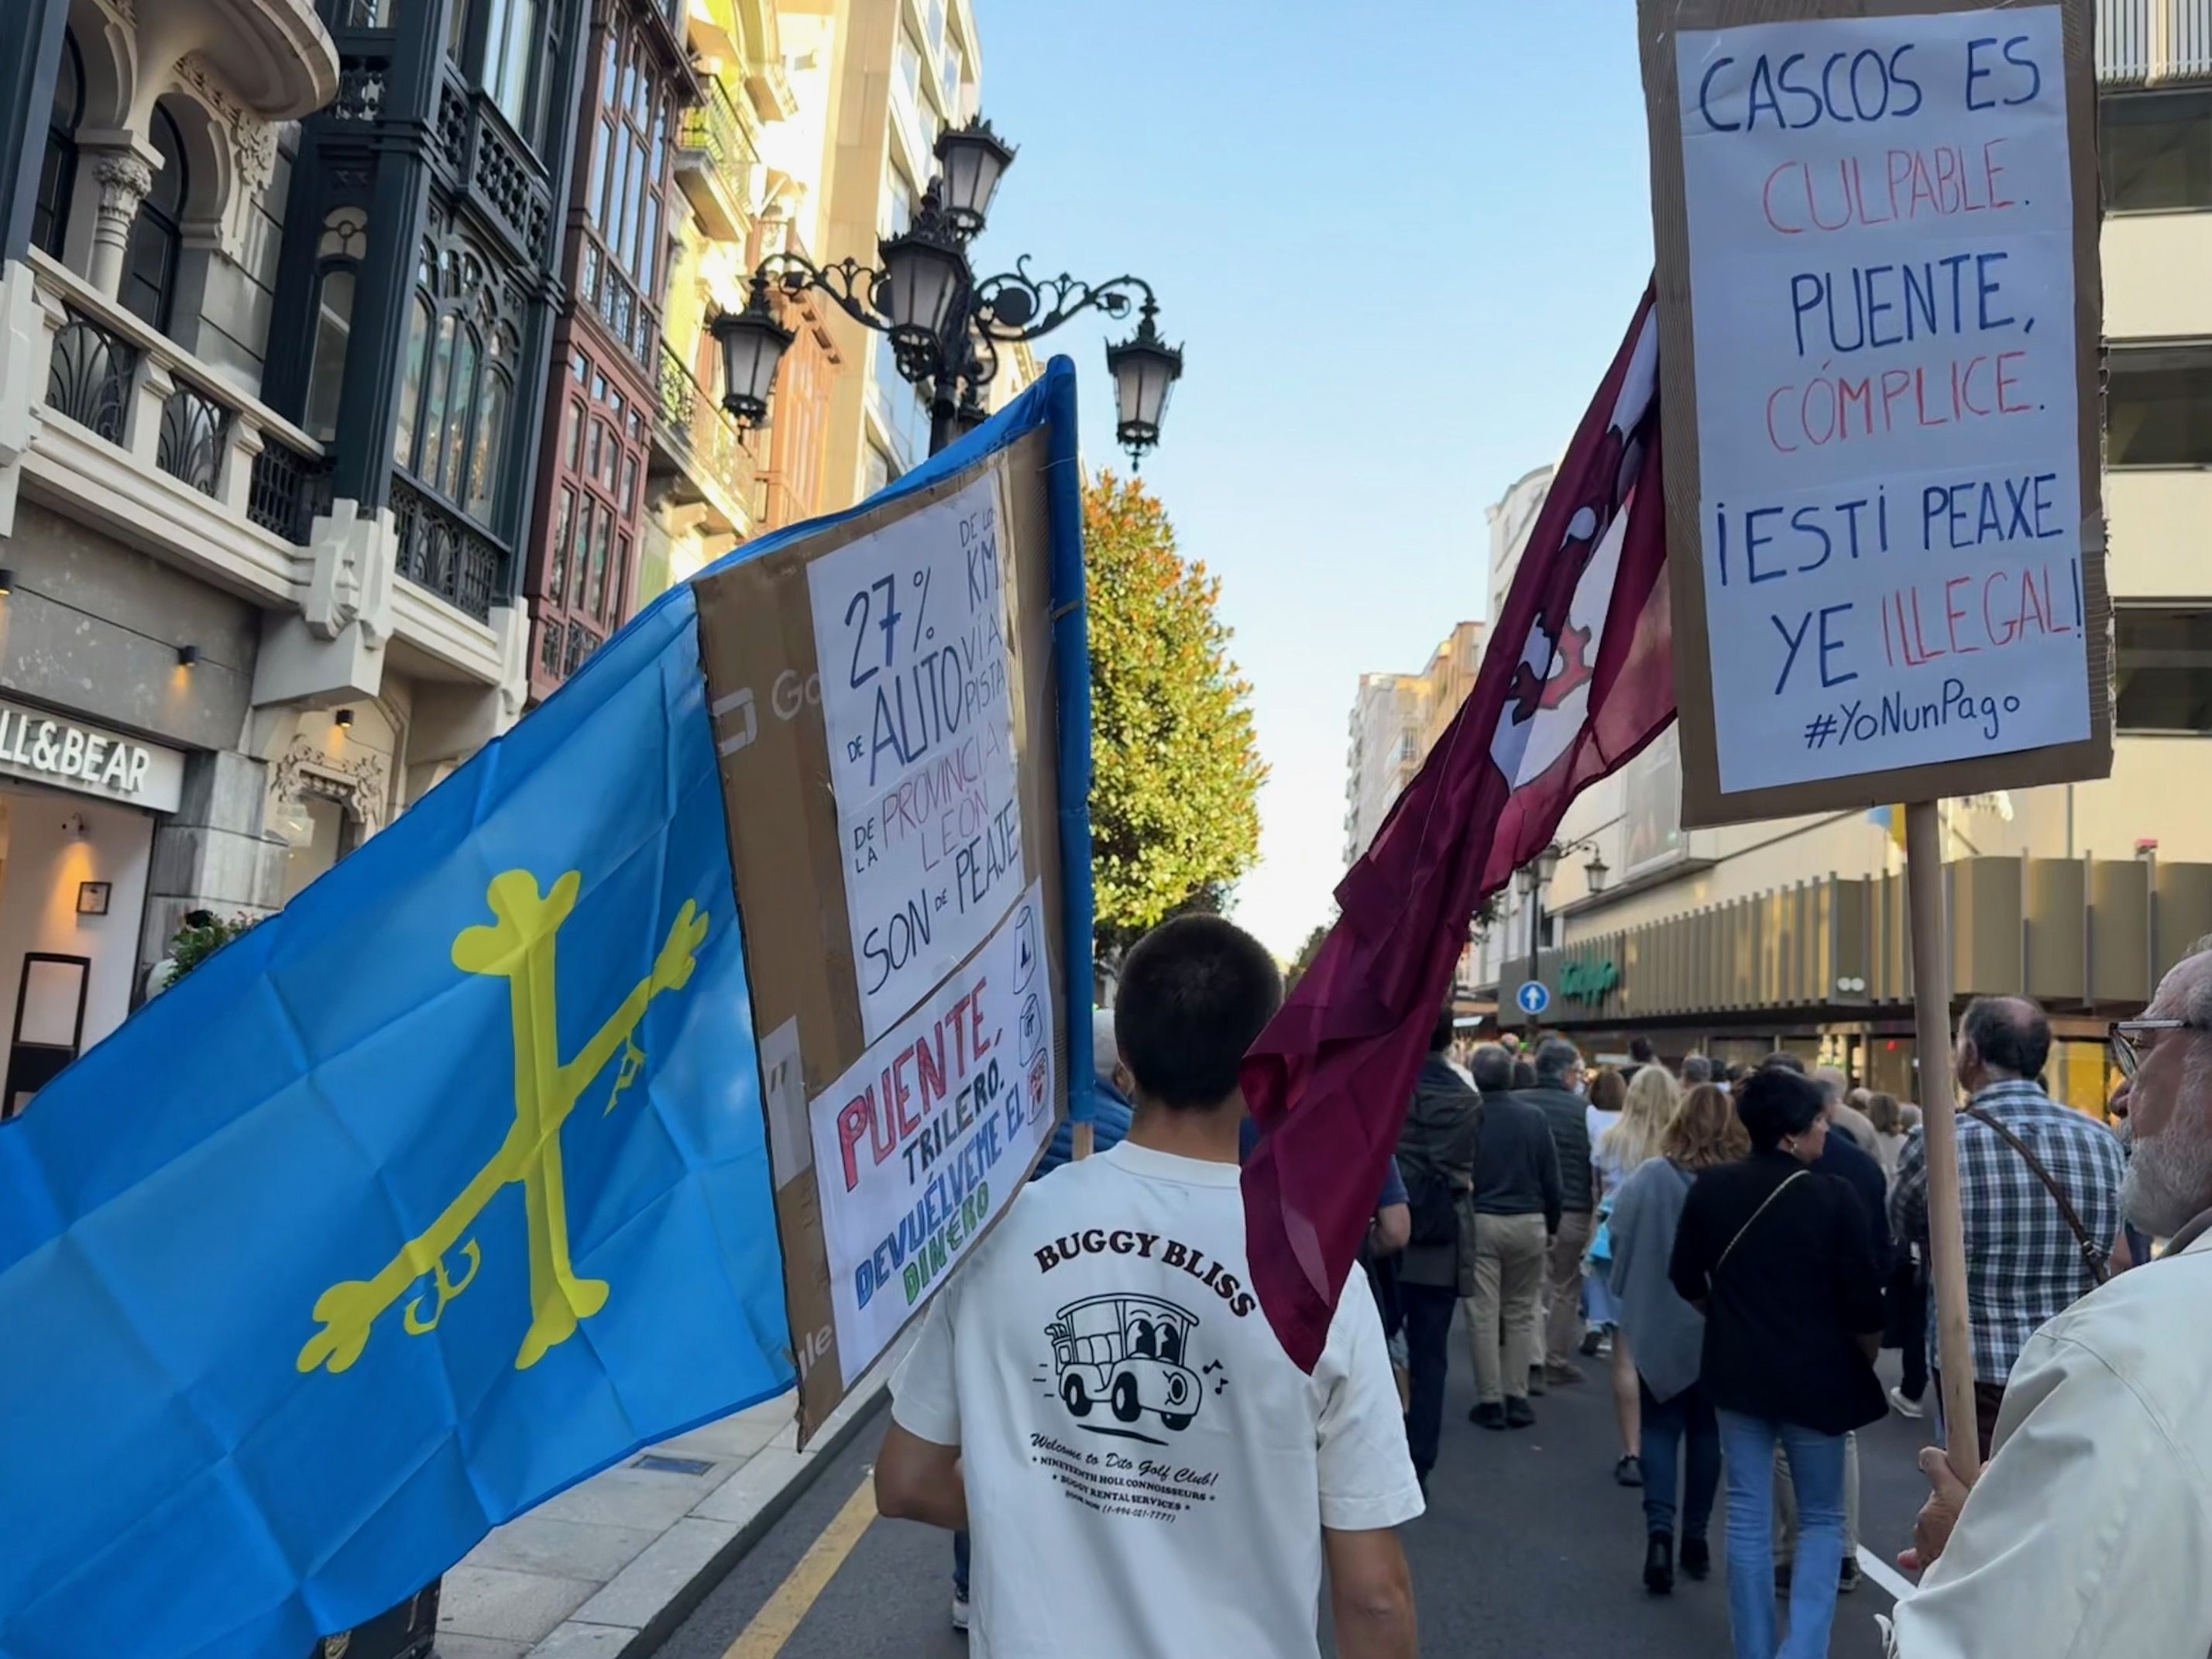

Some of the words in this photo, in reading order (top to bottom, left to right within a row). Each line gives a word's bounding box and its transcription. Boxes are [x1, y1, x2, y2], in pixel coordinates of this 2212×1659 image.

[1699, 44, 1922, 132] CASCOS
[1966, 36, 2041, 110] ES
[1762, 138, 2031, 234] CULPABLE.
[1791, 252, 2035, 356] PUENTE,
[1766, 351, 2045, 452] CÓMPLICE.
[959, 513, 977, 548] DE
[1922, 472, 2064, 551] PEAXE
[1771, 603, 1858, 695] YE
[1882, 558, 2083, 667] ILLEGAL!
[965, 658, 1005, 723] PISTA
[1804, 678, 2020, 748] #YoNunPago
[847, 736, 864, 763] DE
[854, 817, 874, 850] DE
[882, 722, 1001, 850] PROVINCIA
[855, 846, 878, 873] LA
[863, 888, 931, 995] SON
[935, 888, 947, 912] DE
[955, 799, 1018, 914] PEAJE
[836, 976, 1003, 1192] PUENTE,
[902, 1057, 1005, 1185] TRILERO.
[855, 1110, 1002, 1310] DEVUÉLVEME
[1006, 1082, 1025, 1142] EL
[1034, 1229, 1159, 1273] BUGGY
[1162, 1240, 1256, 1317] BLISS
[1030, 1433, 1082, 1460] Welcome
[1086, 1453, 1098, 1465] to
[1139, 1460, 1171, 1482] Golf
[1173, 1468, 1219, 1486] Club!
[1040, 1456, 1097, 1482] NINETEENTH
[1099, 1475, 1125, 1486] HOLE
[1126, 1479, 1206, 1501] CONNOISSEURS
[1060, 1475, 1088, 1494] BUGGY
[1090, 1488, 1130, 1503] RENTAL
[1132, 1495, 1181, 1511] SERVICES
